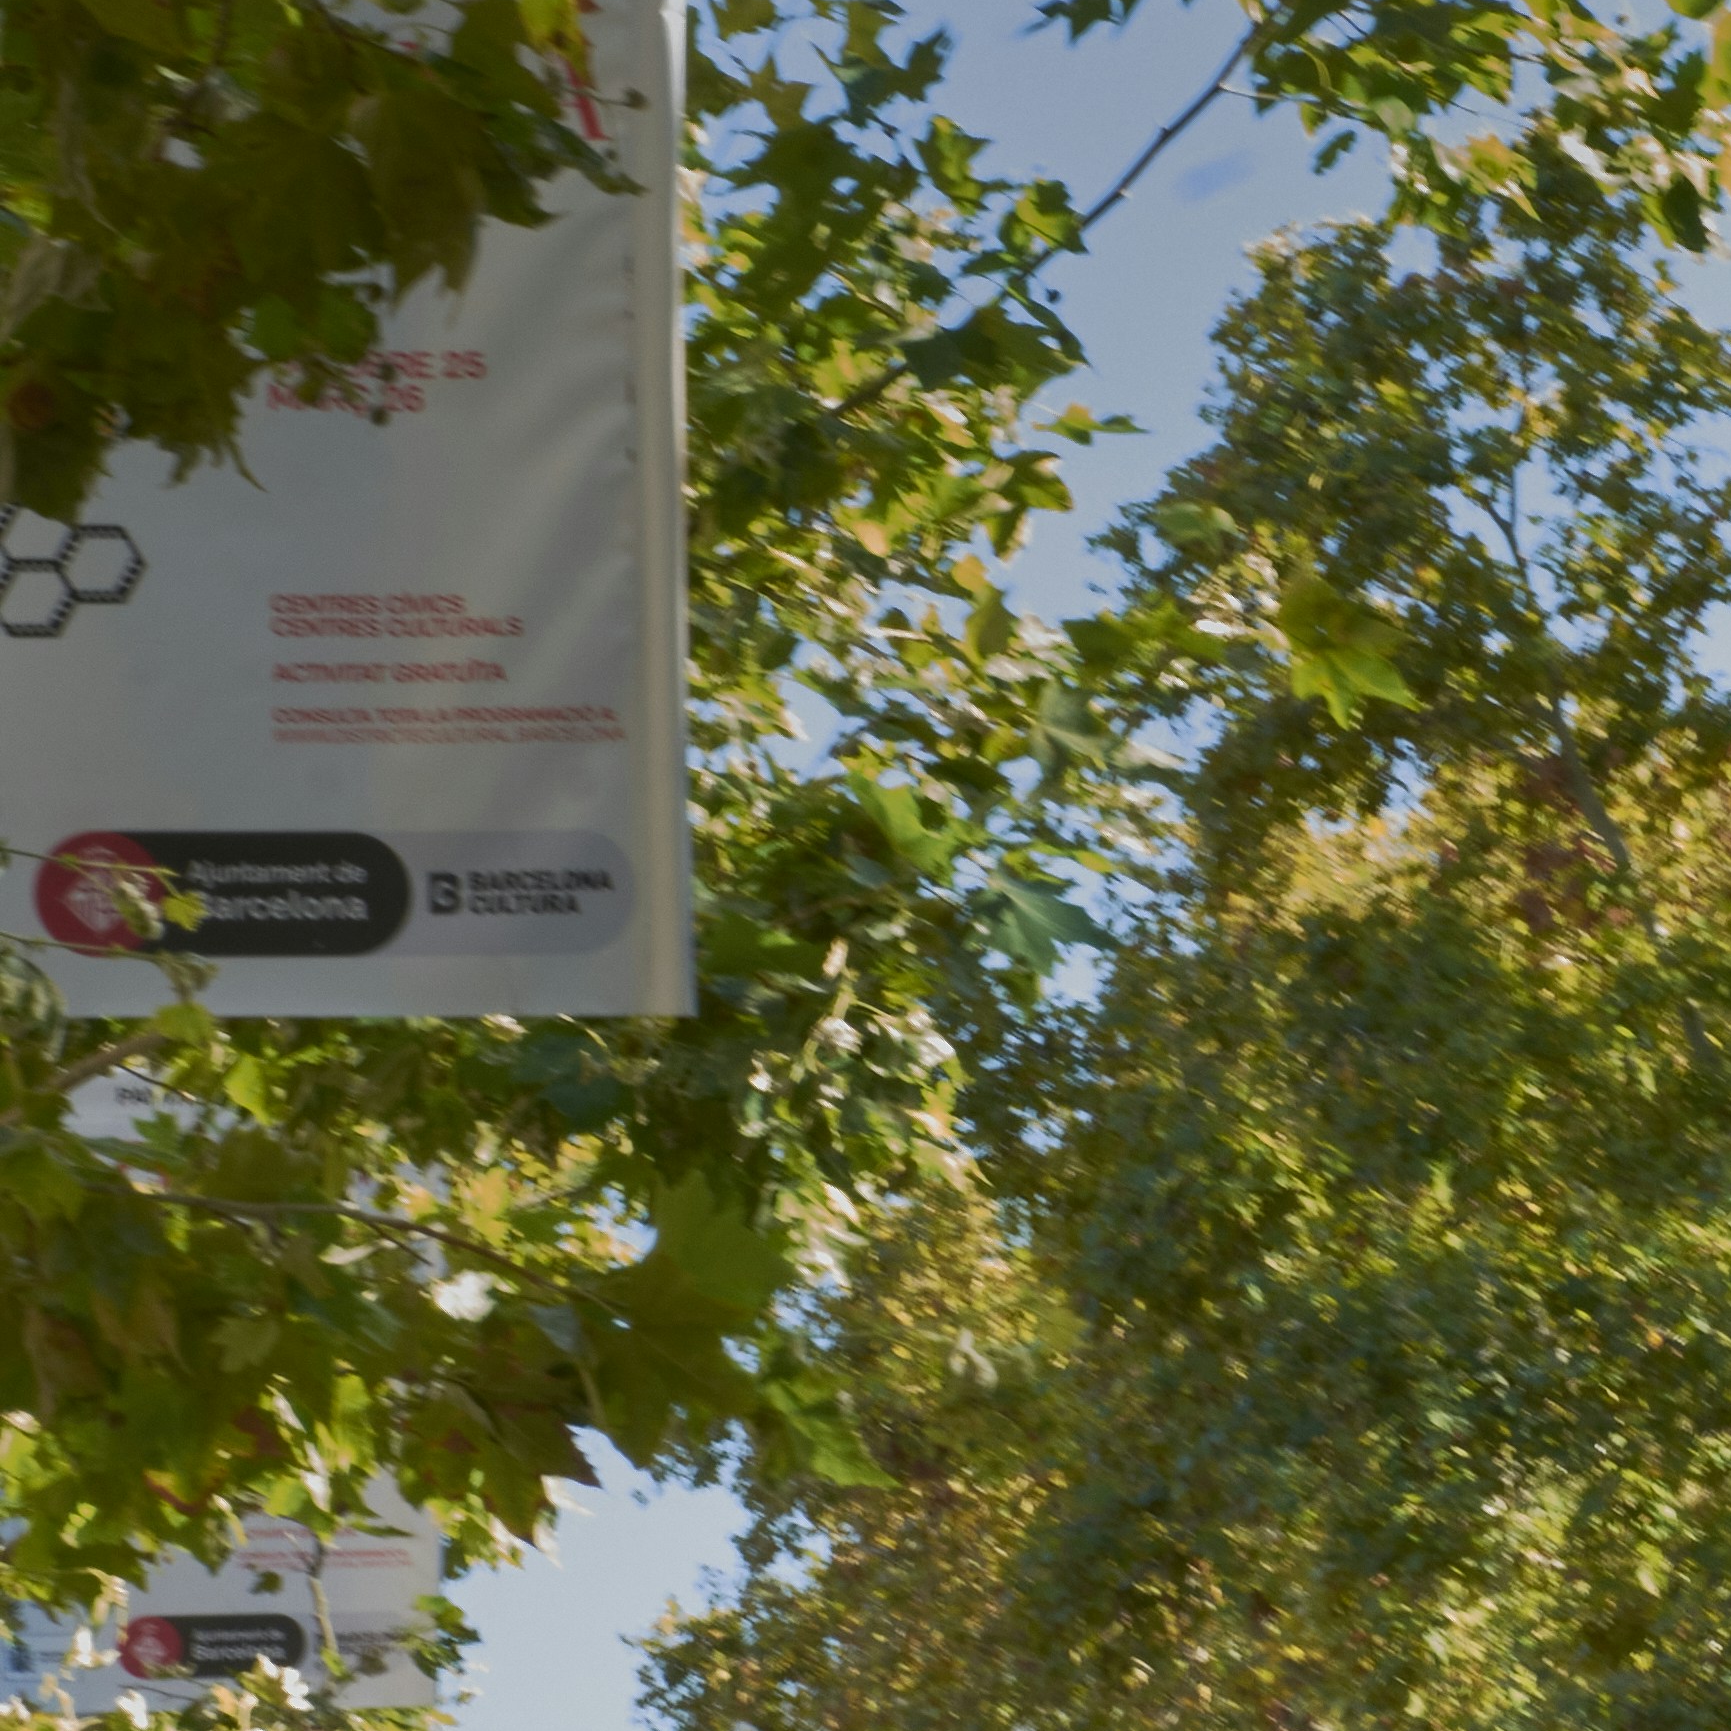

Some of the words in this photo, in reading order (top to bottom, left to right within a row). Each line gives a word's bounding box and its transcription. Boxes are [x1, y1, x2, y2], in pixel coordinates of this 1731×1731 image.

[270, 593, 381, 614] CENTRES
[270, 617, 381, 638] CENTRES
[386, 615, 524, 638] CULTURALS
[272, 663, 385, 683] ACTIVITAT
[187, 860, 331, 888] Ajuntament
[333, 859, 369, 884] de
[468, 871, 615, 891] BARCELONA
[468, 894, 582, 914] CULTURA
